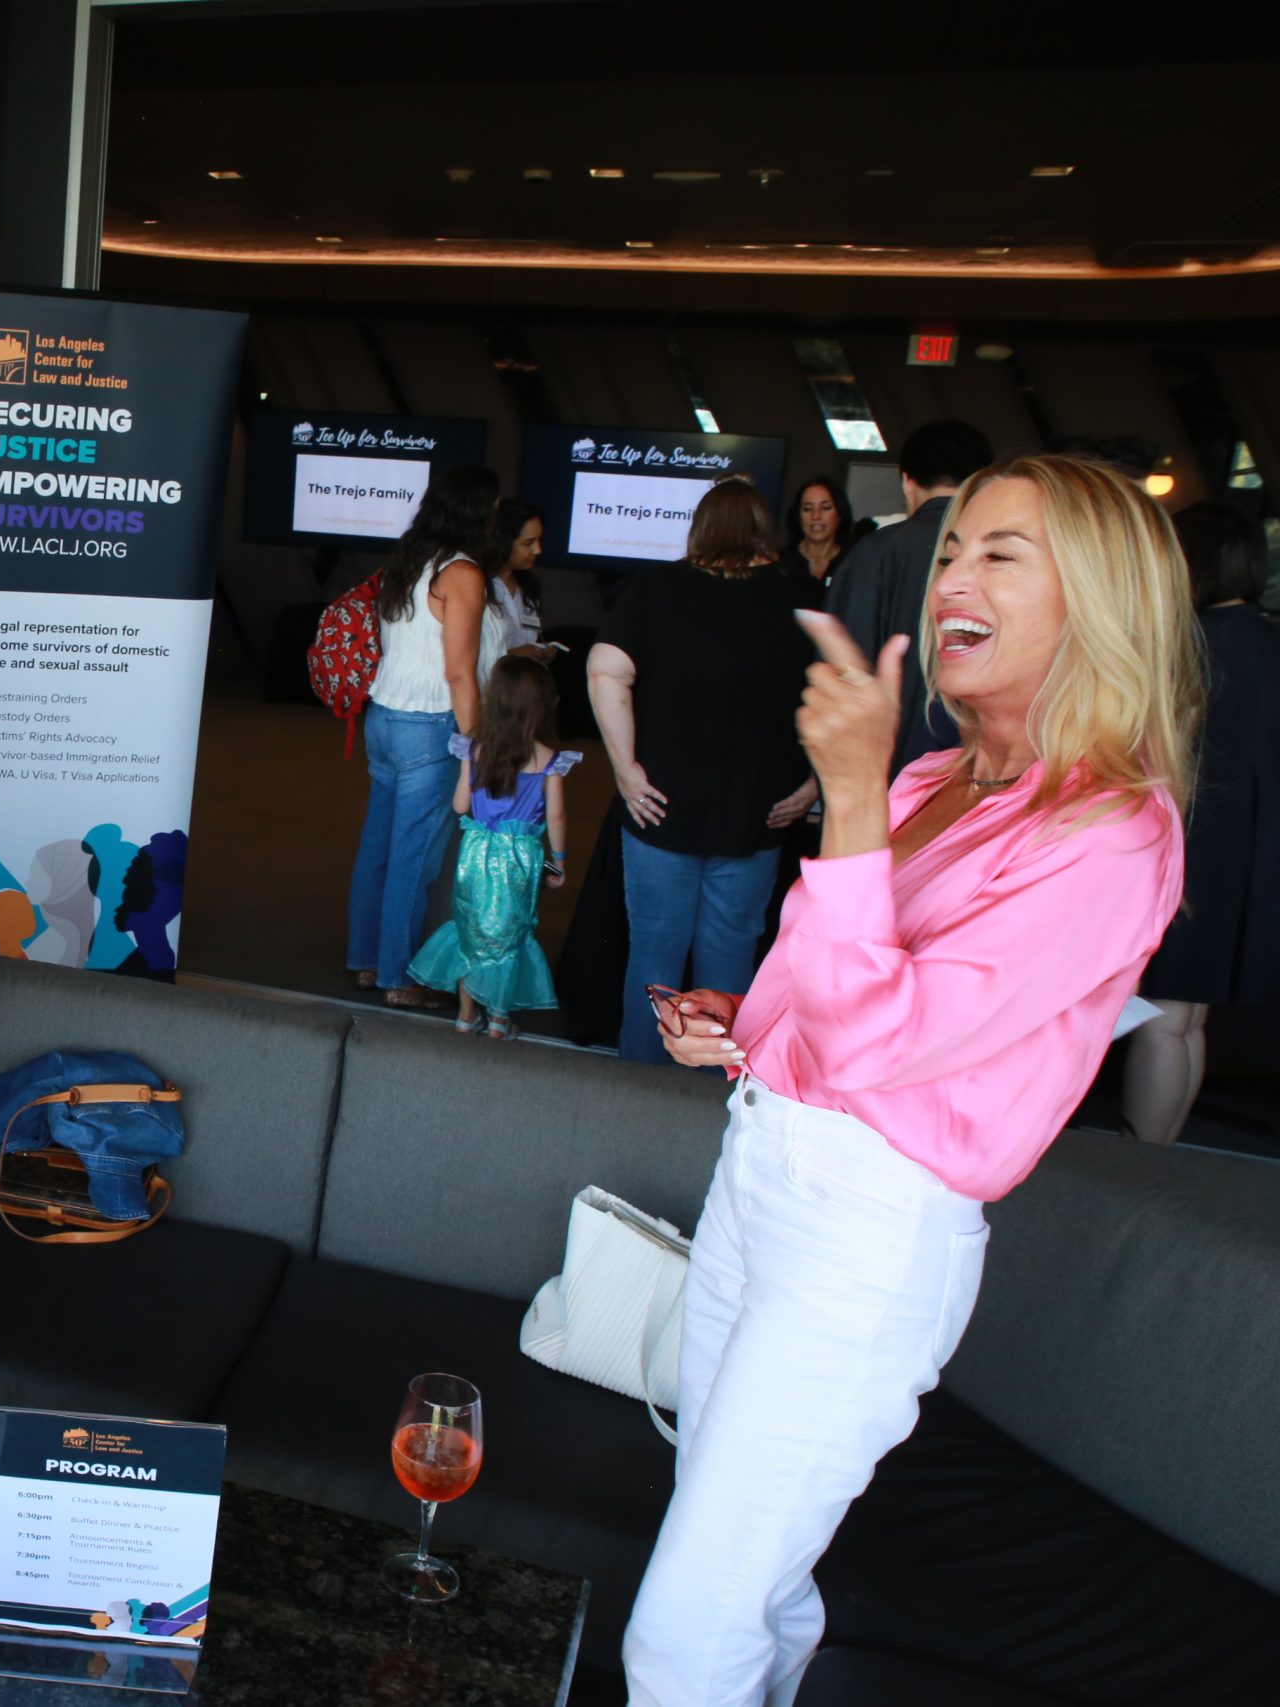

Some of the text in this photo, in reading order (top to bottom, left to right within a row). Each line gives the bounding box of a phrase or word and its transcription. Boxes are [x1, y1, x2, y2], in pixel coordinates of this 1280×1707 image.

[36, 334, 104, 352] Los Angeles
[917, 336, 953, 362] EXIT
[34, 352, 94, 368] Center for
[33, 371, 128, 389] Law and Justice
[316, 428, 437, 449] Tee Up for Survivors
[597, 443, 732, 468] Tee Up for Survivors
[308, 483, 414, 503] The Trejo Family
[587, 503, 694, 520] The Trejo Fami
[24, 622, 118, 637] representation
[122, 624, 140, 637] for
[32, 641, 91, 654] survivors
[95, 642, 110, 654] of
[112, 644, 170, 657] domestic
[10, 658, 35, 669] and
[39, 660, 80, 670] sexual
[83, 662, 129, 673] assault
[50, 693, 88, 704] Orders
[34, 712, 70, 723] Orders
[29, 732, 62, 744] Rights
[65, 732, 117, 745] Advocacy
[66, 752, 128, 764] Immigration
[130, 754, 160, 764] Relief
[20, 770, 28, 780] U
[32, 770, 58, 781] Visa,
[61, 771, 68, 780] T
[70, 772, 94, 782] Visa
[96, 772, 160, 784] Applications
[46, 1459, 157, 1481] PROGRAM
[18, 1491, 53, 1501] 6:00pm
[71, 1497, 111, 1506] Check-in
[123, 1501, 166, 1512] Warm-up
[17, 1511, 52, 1521] 6:30pm
[71, 1517, 98, 1525] Buffet
[100, 1519, 131, 1528] Dinner
[143, 1523, 180, 1532] Practice
[16, 1532, 52, 1541] 7:15pm
[70, 1533, 144, 1546] Announcements
[69, 1541, 152, 1554] Tournament Rules
[16, 1552, 50, 1560] 7:30pm
[68, 1557, 124, 1568] Tournament
[15, 1570, 50, 1579] 8:45pm
[68, 1571, 123, 1583] Tournament
[125, 1578, 174, 1589] Conclusion
[67, 1580, 100, 1588] Awards
